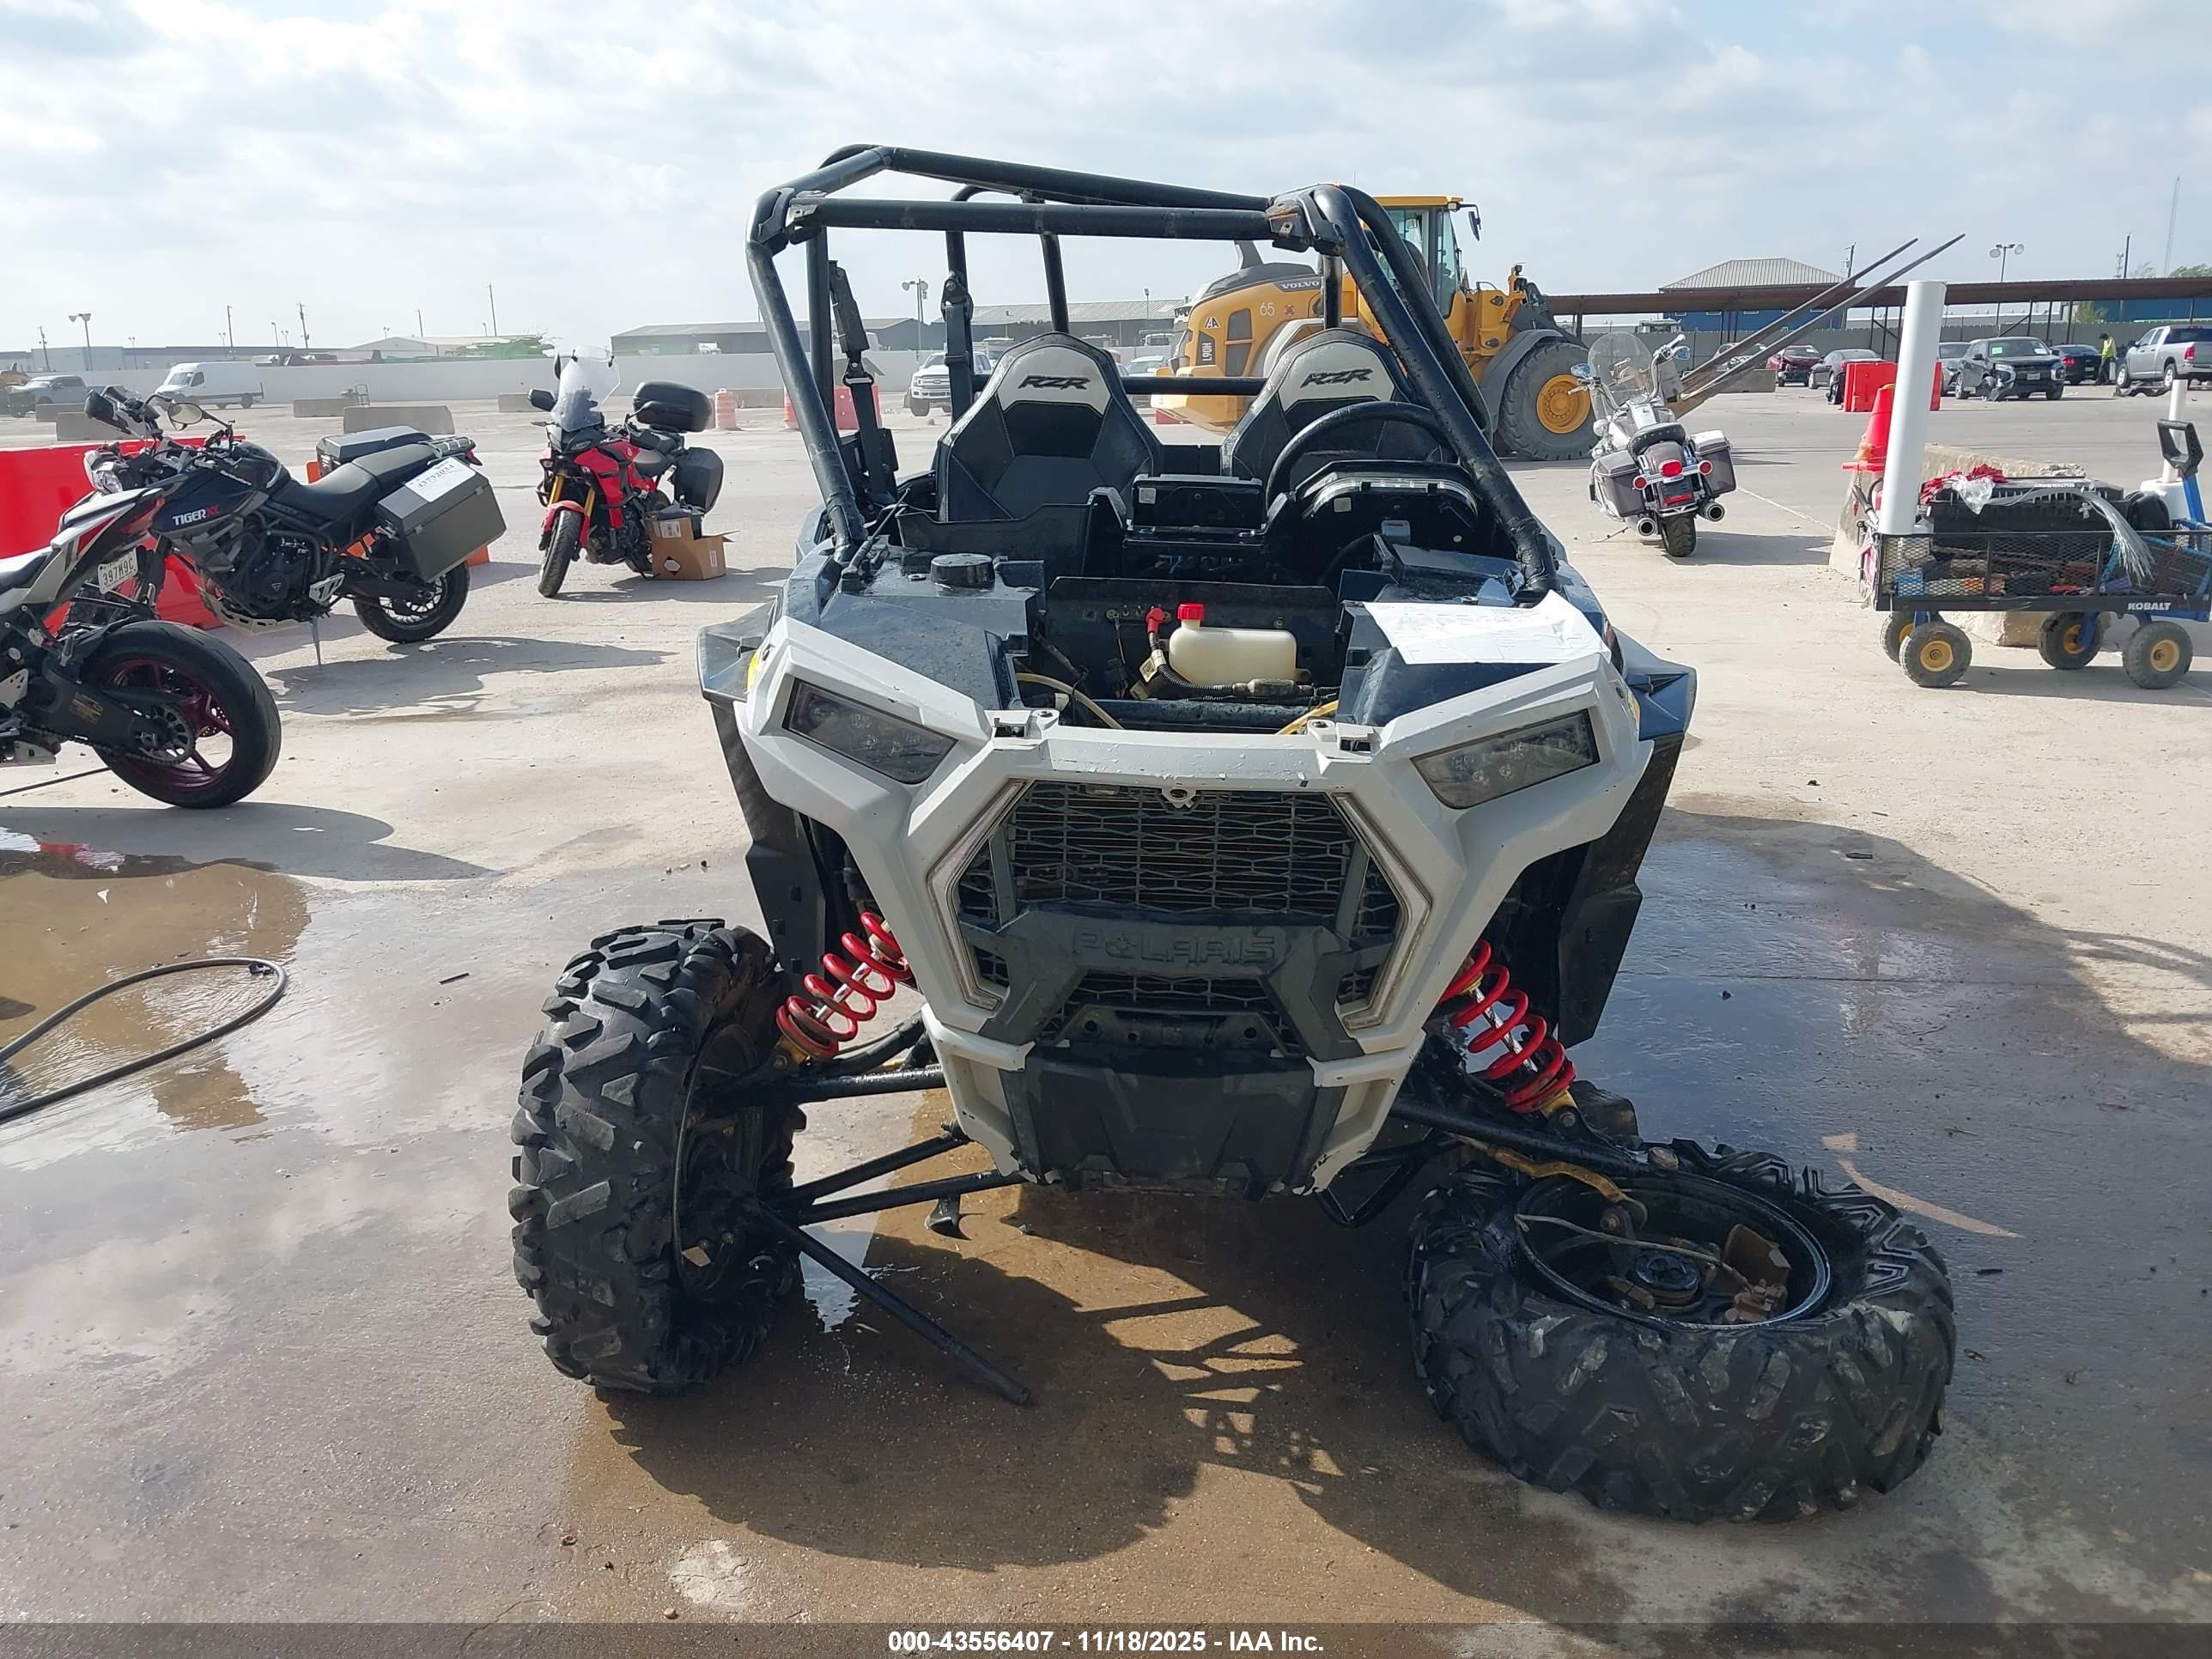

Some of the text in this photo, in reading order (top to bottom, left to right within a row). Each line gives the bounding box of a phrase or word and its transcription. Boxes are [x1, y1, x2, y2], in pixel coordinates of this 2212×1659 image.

[1260, 302, 1275, 316] 65
[1202, 343, 1212, 362] L90H
[1018, 375, 1091, 390] RZR
[1300, 369, 1373, 388] RZR
[172, 508, 206, 526] TIGER
[103, 558, 134, 585] 397M9C
[1073, 927, 1278, 964] POLARIS
